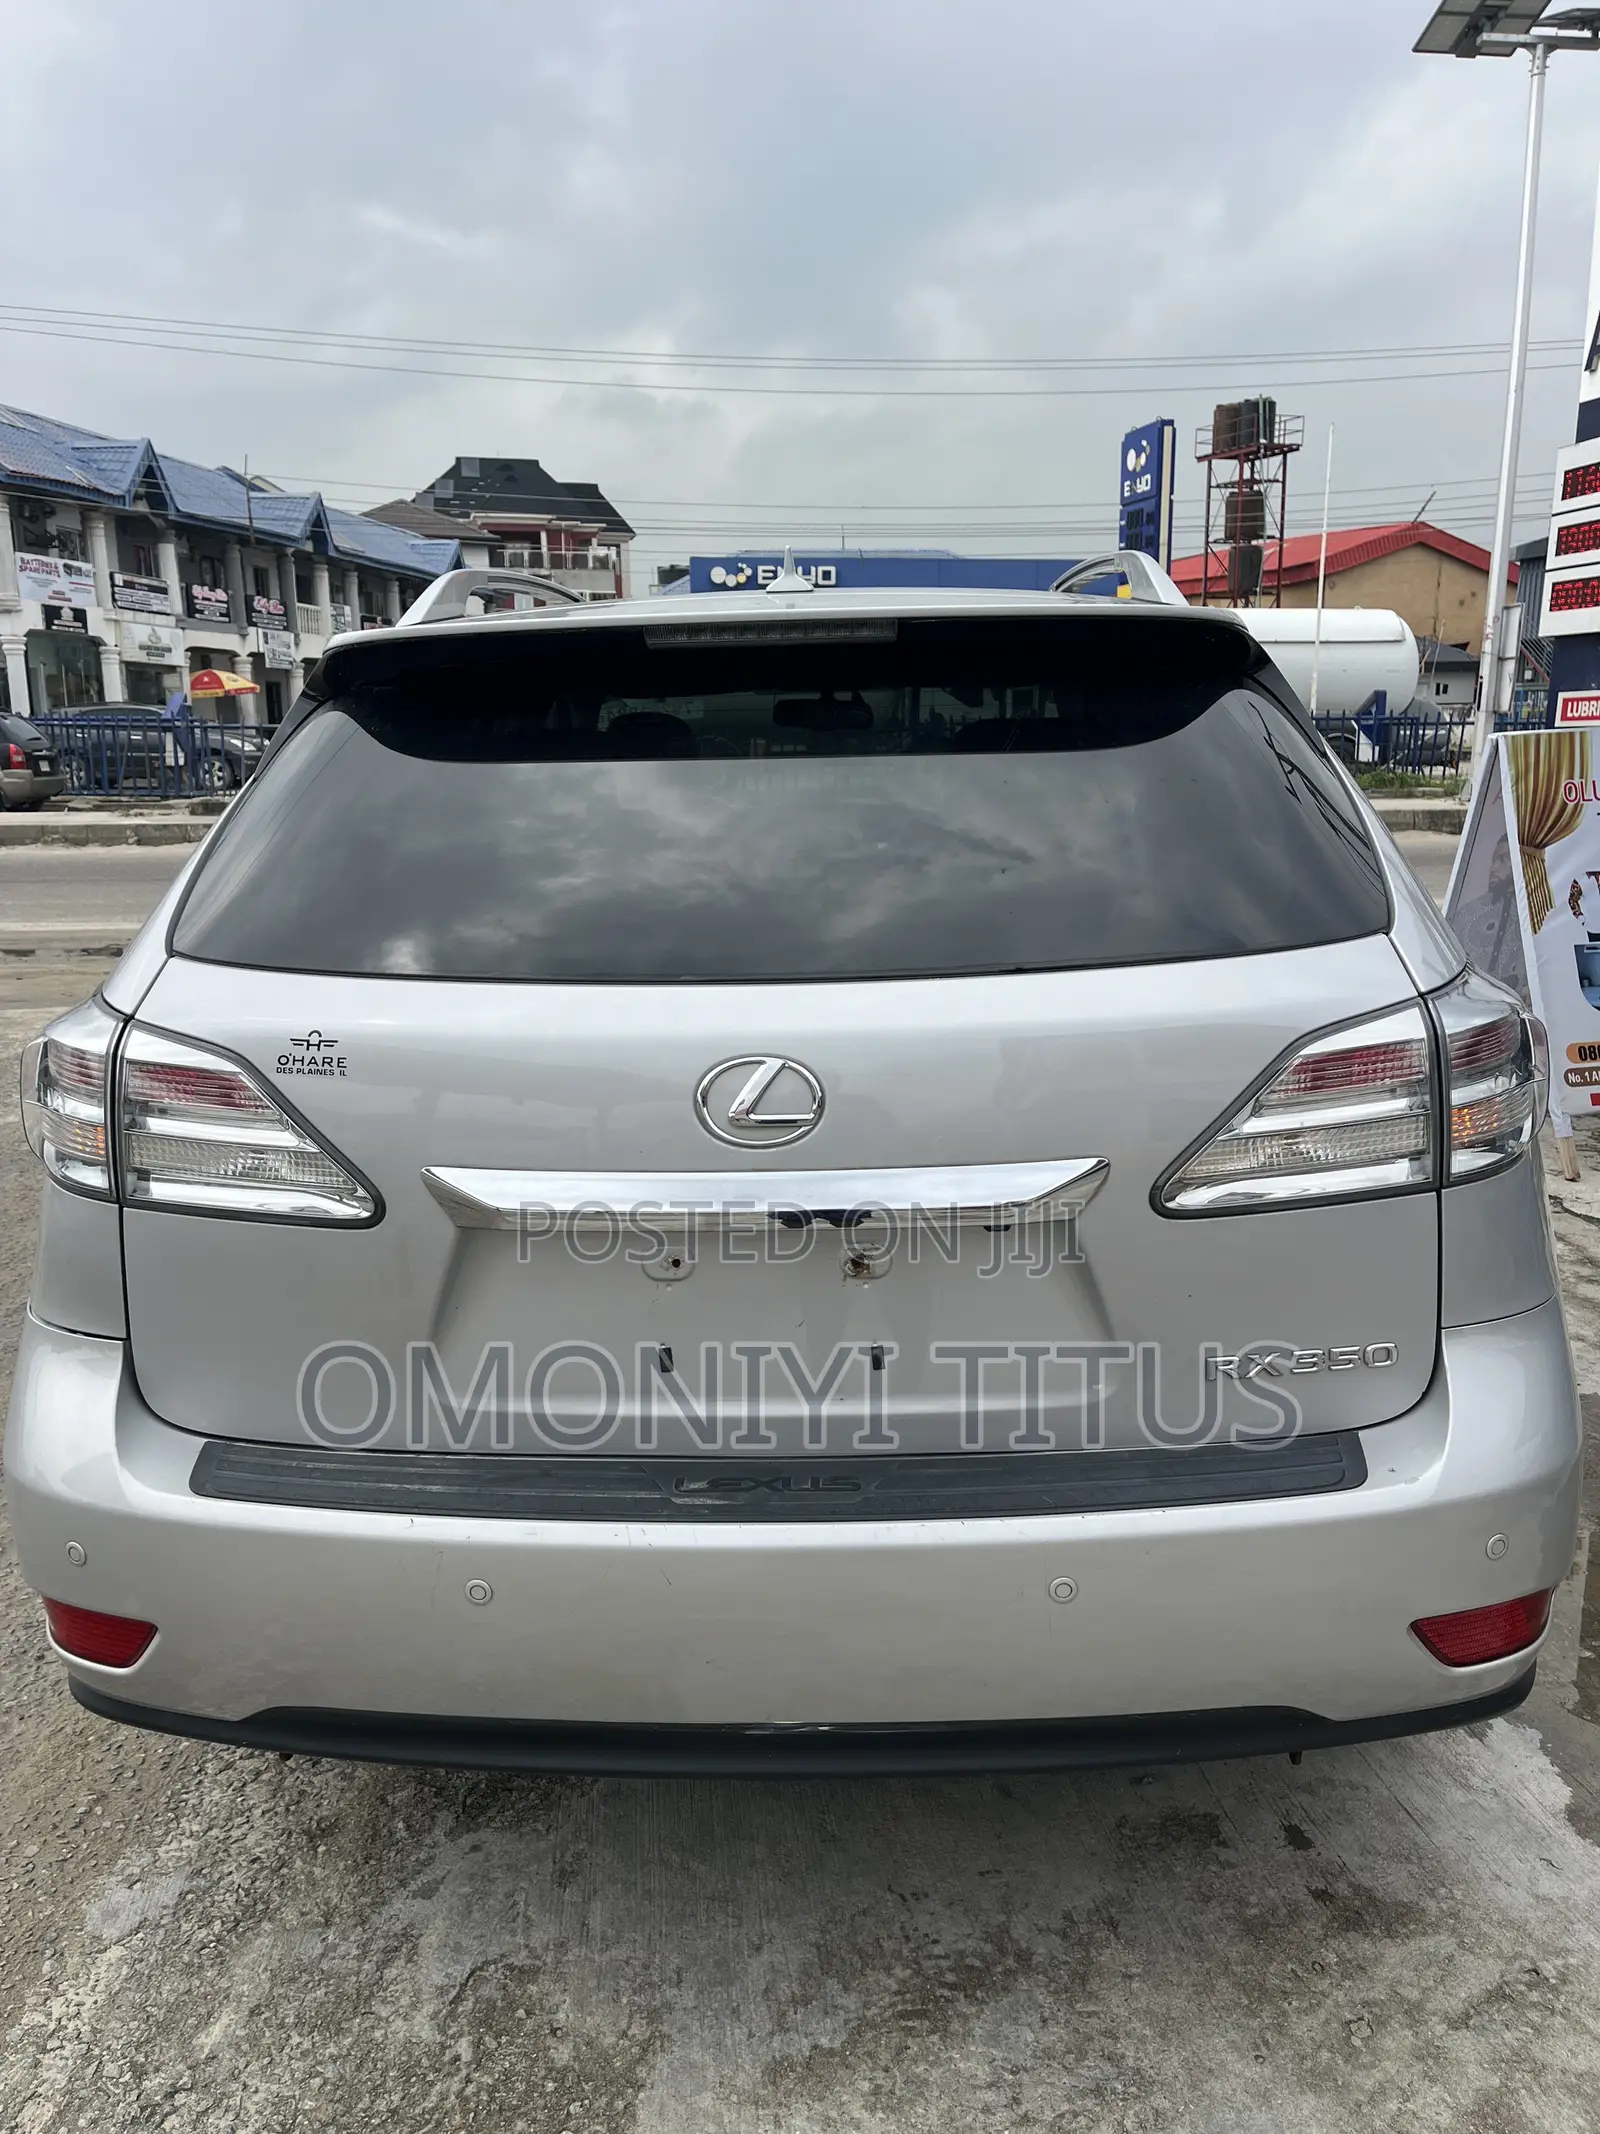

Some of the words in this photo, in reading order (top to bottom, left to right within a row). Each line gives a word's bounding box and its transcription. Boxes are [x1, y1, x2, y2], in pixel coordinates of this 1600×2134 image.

[277, 1053, 347, 1068] O'HARE
[1578, 1045, 1600, 1061] 08
[276, 1066, 294, 1075] DES
[296, 1067, 335, 1076] PLAINES
[339, 1069, 347, 1077] IL
[1568, 1072, 1583, 1084] No.
[1584, 1071, 1590, 1082] 1
[672, 1475, 863, 1493] LEXUS
